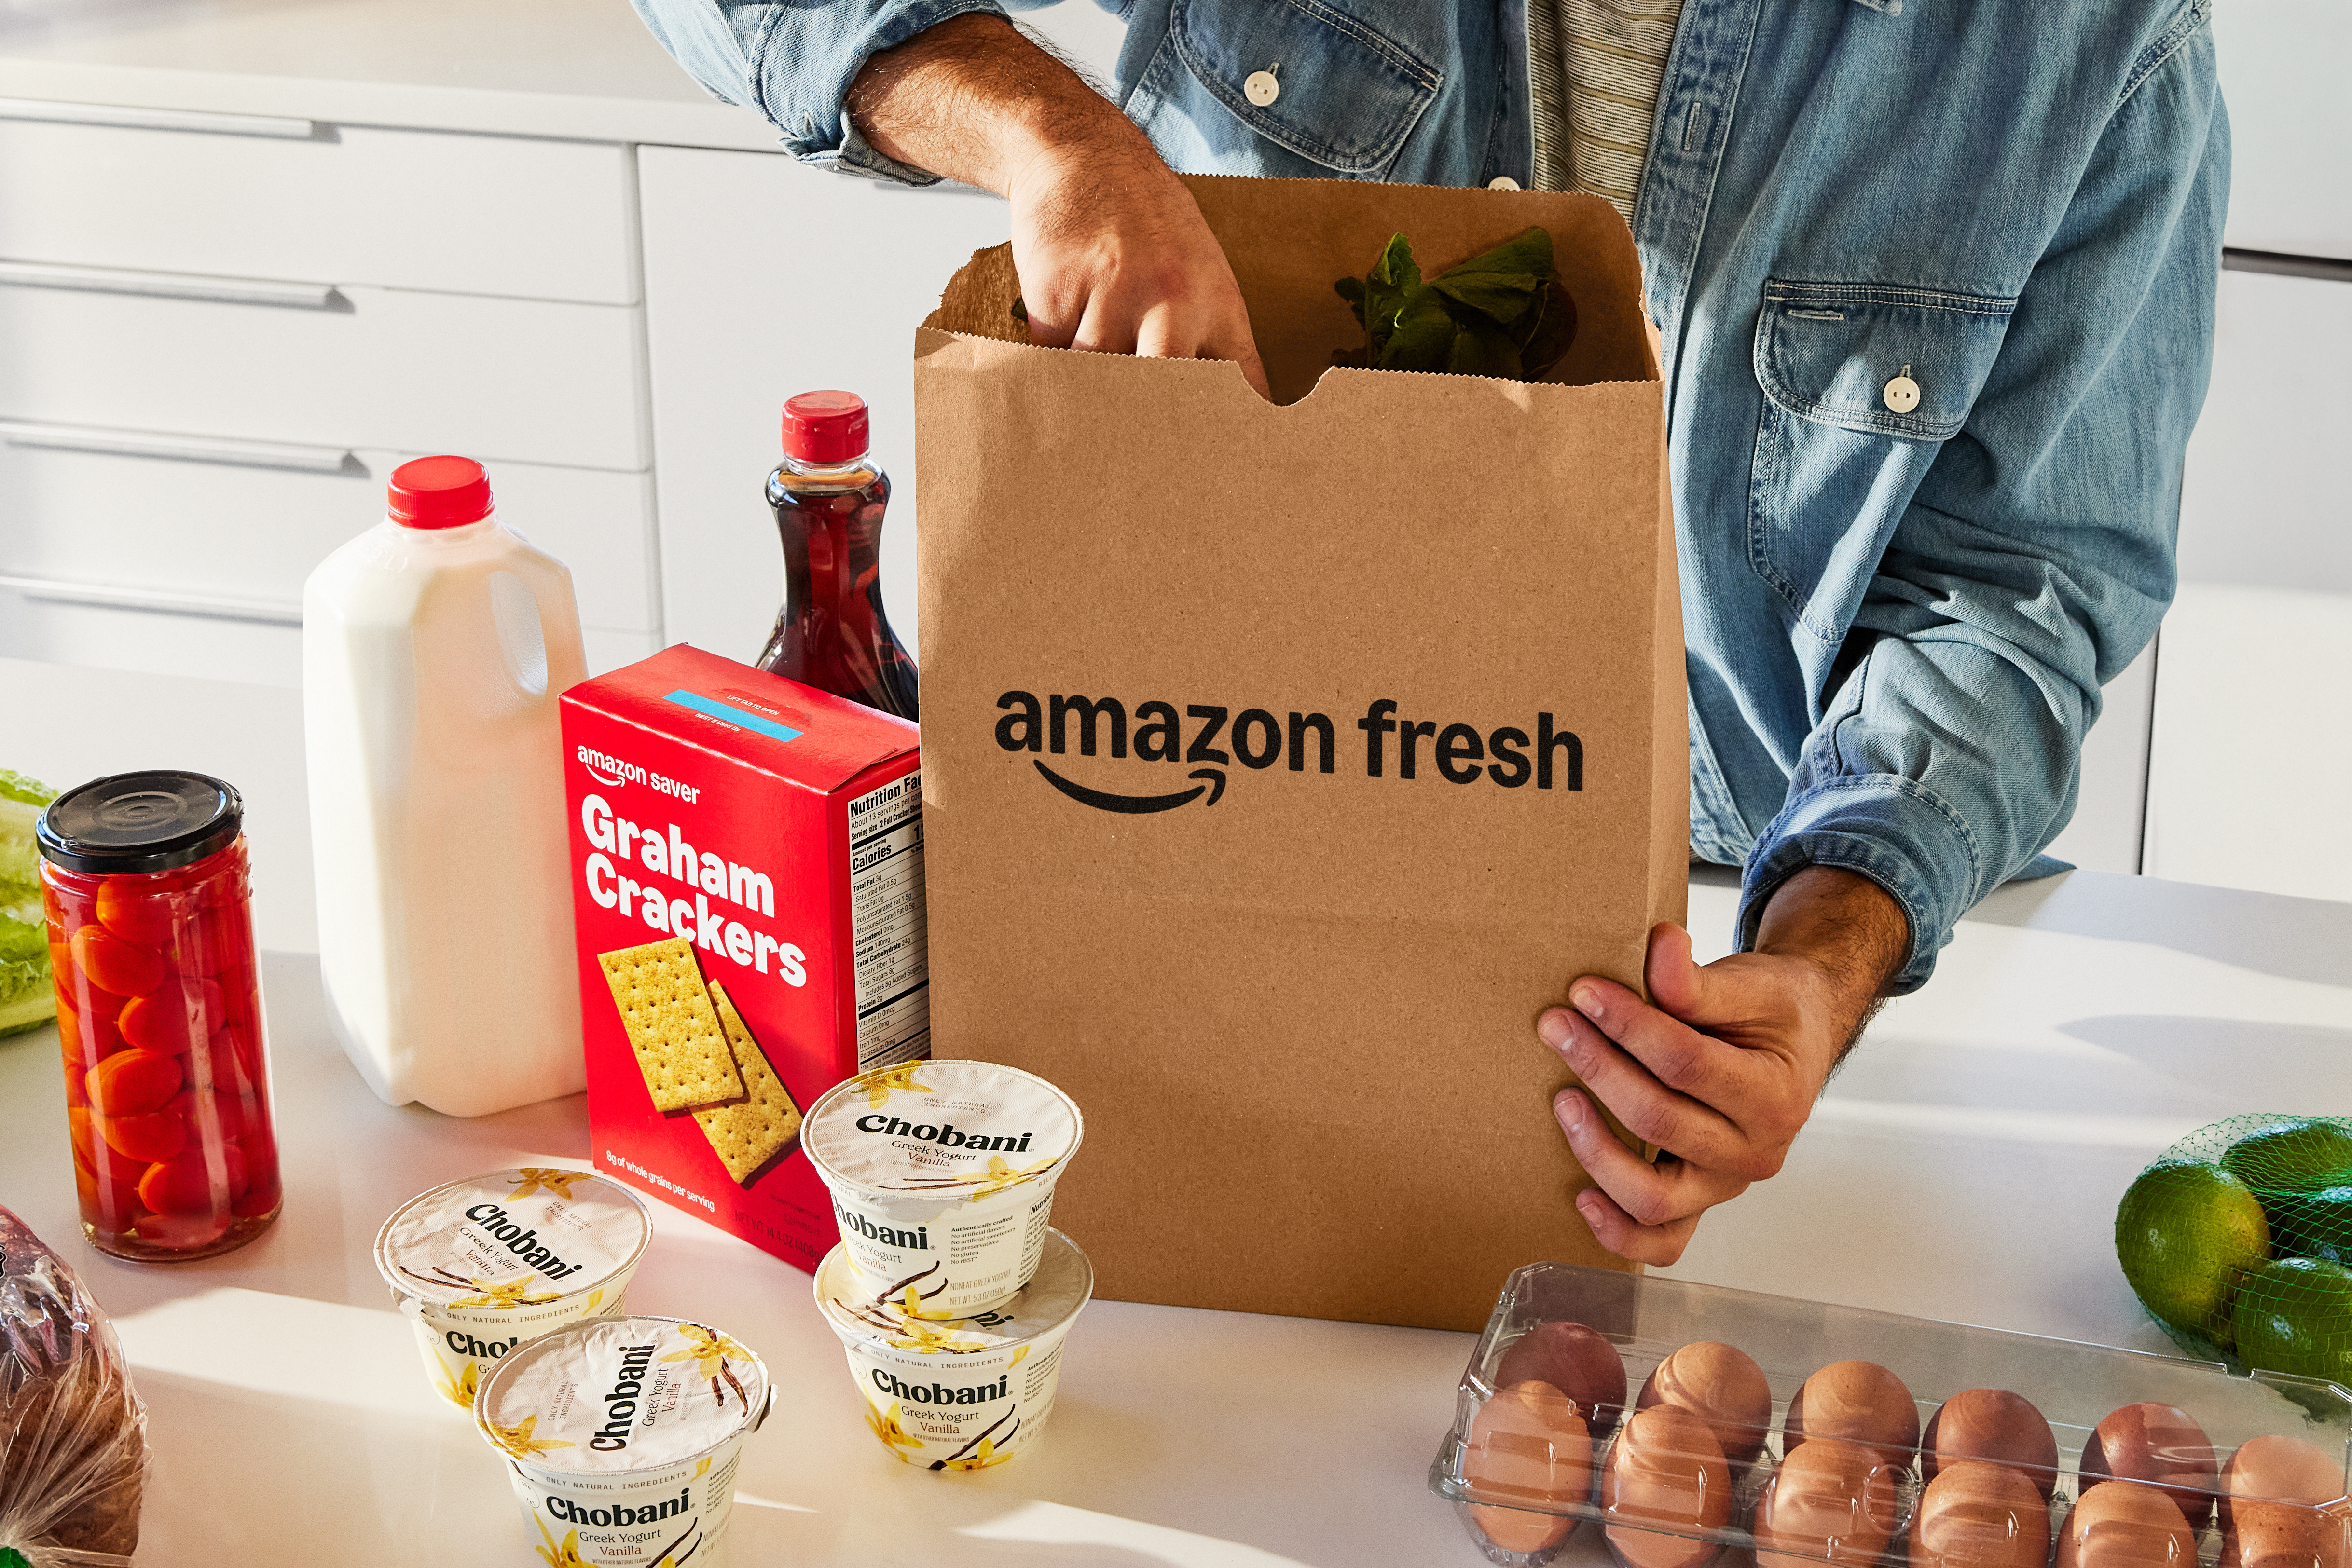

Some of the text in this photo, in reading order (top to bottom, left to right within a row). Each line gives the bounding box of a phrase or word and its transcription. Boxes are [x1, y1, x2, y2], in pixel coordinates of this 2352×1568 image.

[761, 707, 779, 715] OPEN
[995, 690, 1583, 791] amazon fresh
[578, 745, 700, 804] amazon saver
[851, 775, 921, 818] Nutrition Fac
[851, 817, 867, 830] About
[878, 803, 899, 818] servings
[852, 829, 867, 841] Serving
[869, 824, 877, 833] size
[894, 809, 909, 821] Cracker
[582, 794, 774, 918] Graham
[853, 847, 866, 857] Amount
[874, 838, 886, 847] serving
[853, 845, 891, 870] Calories
[853, 882, 866, 892] Total
[856, 888, 877, 902] Saturated
[887, 879, 896, 887] 0.5g
[857, 903, 869, 913] Trans
[857, 902, 892, 924] Polyunsaturated
[902, 893, 911, 901] 1.5g
[857, 911, 896, 935] Monounsaturated
[905, 903, 914, 911] 0.5g
[586, 853, 807, 987] Crackers
[855, 924, 894, 946] Cholesterol 0mg
[856, 937, 890, 957] Sodium 140mg
[856, 958, 868, 968] Total
[870, 942, 901, 962] Carbohydrate
[859, 967, 875, 978] Dietary
[877, 960, 887, 970] Fiber
[860, 979, 871, 989] Total
[872, 971, 888, 983] Sugars
[866, 984, 884, 997] Includes
[893, 971, 906, 983] Added
[907, 964, 922, 976] Sugars
[858, 999, 876, 1011] Protein
[859, 1016, 876, 1027] Vitamin
[882, 1006, 895, 1016] 0mcg
[859, 1021, 889, 1038] Calcium 0mg
[871, 1035, 880, 1043] 1mg
[860, 1044, 884, 1060] Potassium
[885, 1038, 895, 1047] 0mg
[856, 1115, 1032, 1152] Chobani
[892, 1141, 977, 1160] Greek Yogurt
[908, 1153, 950, 1167] Vanilla
[606, 1150, 715, 1212] 8g of whole grains per serving
[569, 1213, 592, 1229] NATURAL
[735, 1210, 750, 1227] NET
[752, 1217, 764, 1233] WT
[766, 1225, 781, 1242] 14.4
[783, 1233, 793, 1248] OZ
[831, 1192, 928, 1249] hobani
[951, 1215, 1013, 1232] Authentically crafted
[987, 1225, 1005, 1233] flavors
[465, 1204, 583, 1280] Chobani
[987, 1227, 1016, 1240] sweeteners
[460, 1227, 519, 1270] Greek Yogurt
[845, 1229, 902, 1263] Greek Yogurt
[961, 1240, 999, 1252] preservatives
[465, 1249, 494, 1276] Vanilla
[856, 1250, 886, 1271] Vanilla
[950, 1268, 1011, 1290] NONFAT GREEK YOGURT
[950, 1297, 961, 1305] NET
[973, 1293, 981, 1302] 5.3
[983, 1291, 989, 1299] OZ
[990, 1285, 1005, 1297] (150g)
[519, 1305, 579, 1322] INGREDIENTS
[871, 1349, 889, 1359] ONLY
[895, 1357, 933, 1368] NATURAL
[941, 1357, 1004, 1368] INGREDIENTS
[642, 1369, 669, 1426] Greek Yogurt
[662, 1383, 681, 1412] Vanilla
[872, 1368, 1007, 1405] Chobani
[548, 1380, 568, 1421] ONLY NATURAL
[559, 1383, 578, 1419] INGREDIENTS
[590, 1345, 655, 1451] Chobani
[902, 1406, 979, 1423] Greek Yogurt
[920, 1422, 960, 1434] Vanilla
[546, 1477, 566, 1486] ONLY
[623, 1471, 687, 1489] INGREDIENTS
[546, 1488, 689, 1527] Chobani
[580, 1529, 661, 1543] Greek Yogurt
[600, 1546, 642, 1556] Vanilla
